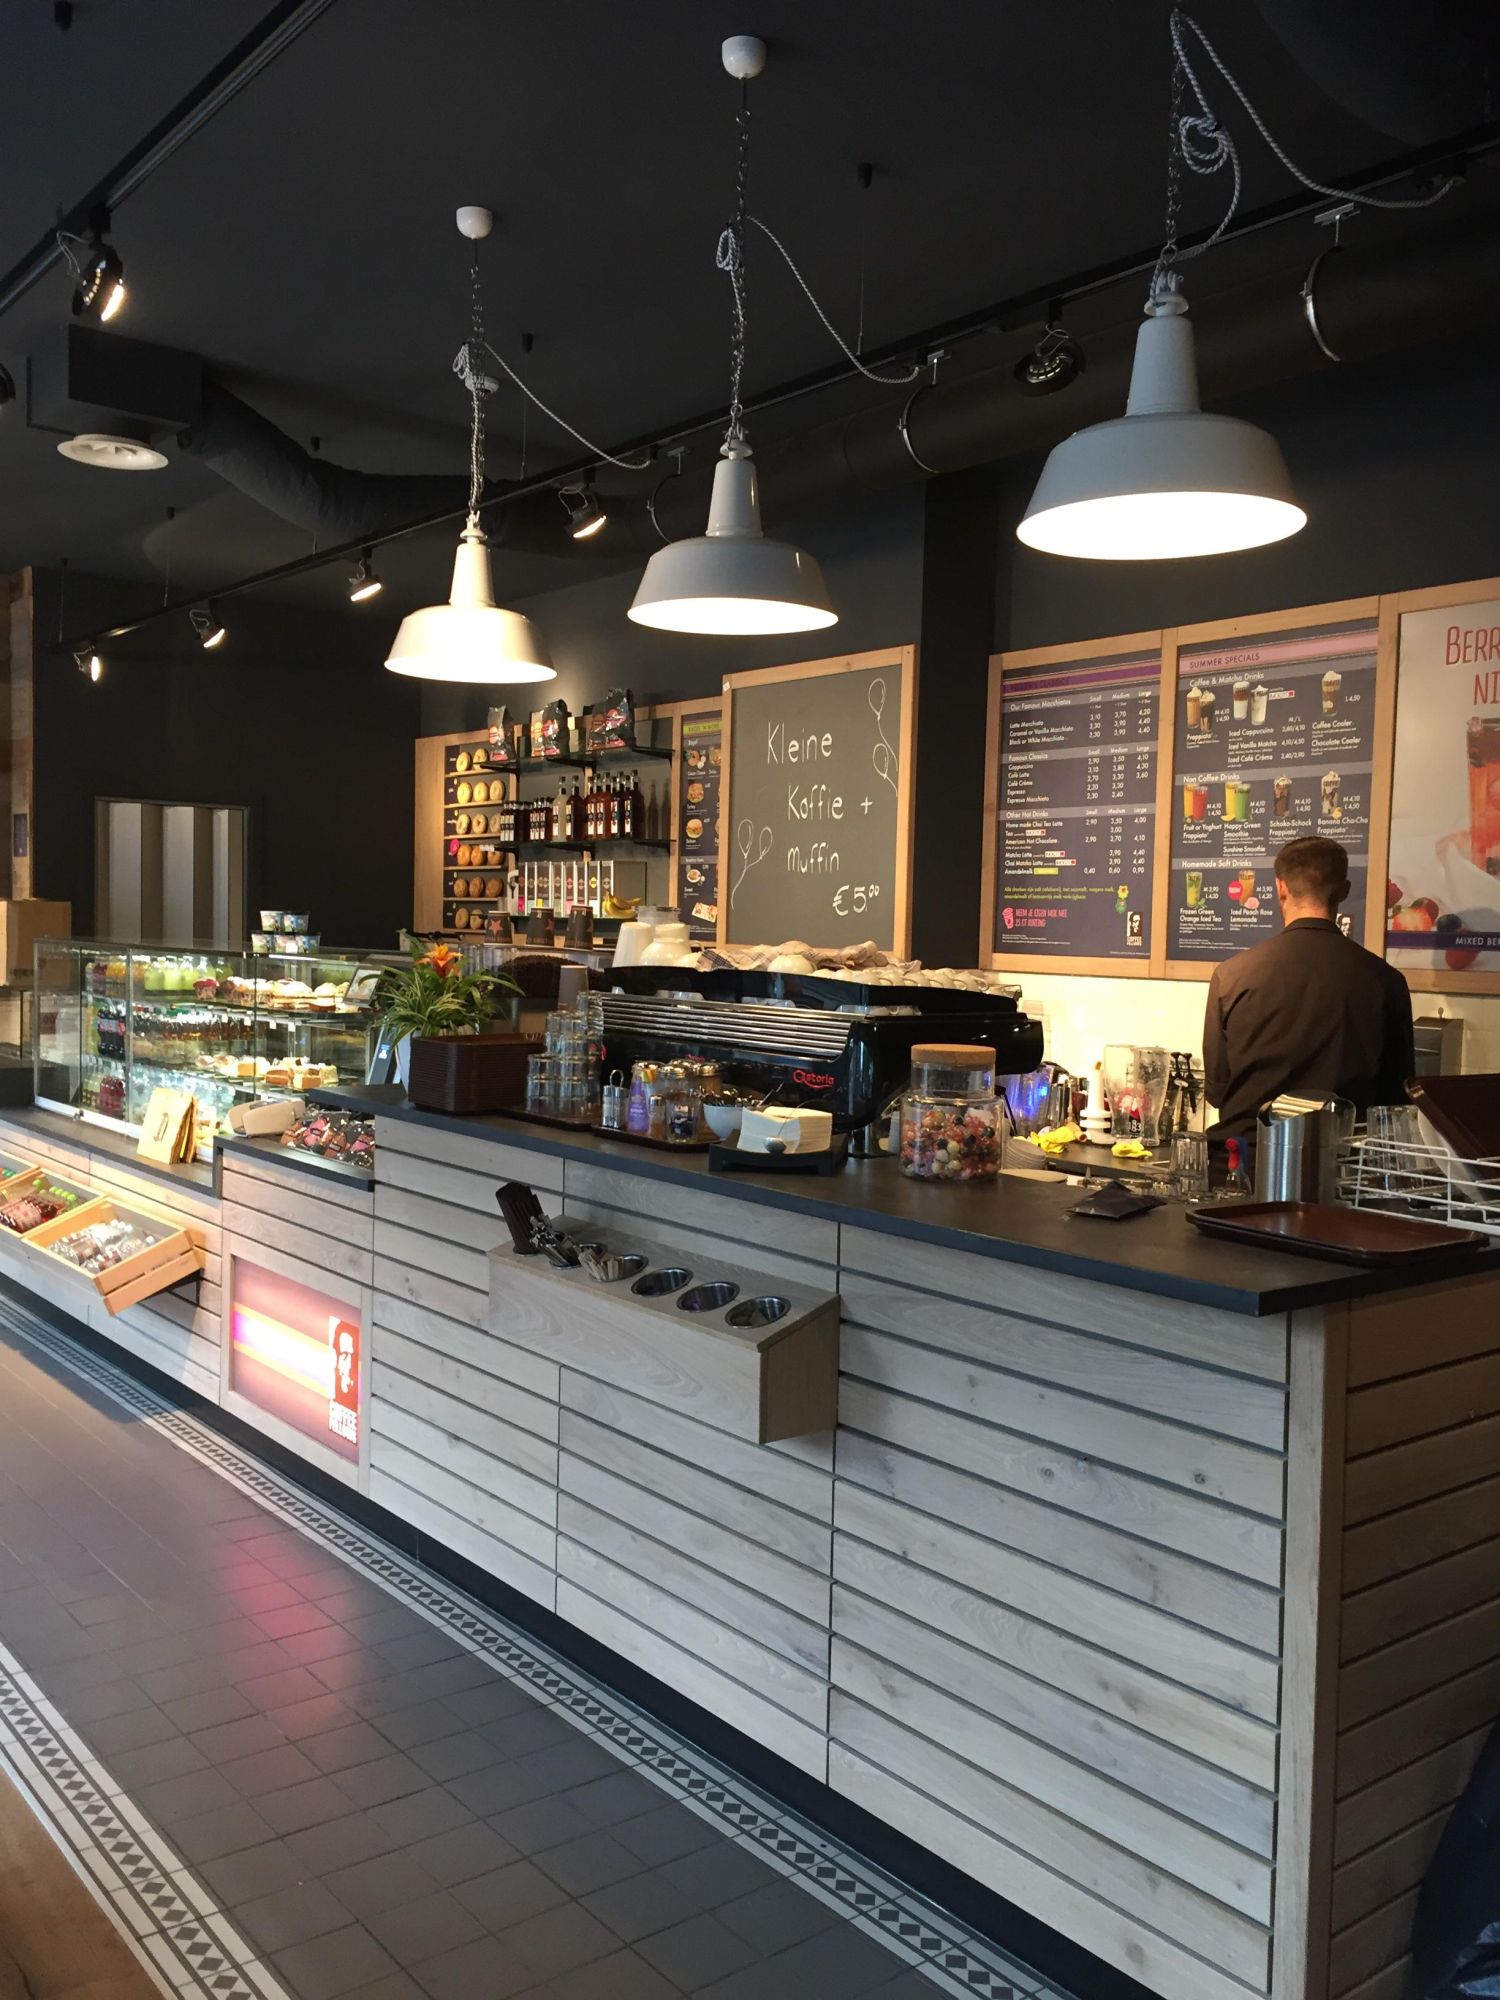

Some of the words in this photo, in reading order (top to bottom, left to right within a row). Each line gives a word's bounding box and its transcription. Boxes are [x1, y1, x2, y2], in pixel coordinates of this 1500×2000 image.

[1190, 657, 1222, 669] SUMMER
[1225, 653, 1260, 664] SPECIALS
[1190, 678, 1209, 687] Coffee
[1219, 675, 1242, 684] Matcha
[1242, 728, 1274, 736] Cappuccino
[768, 721, 832, 764] Kleine
[788, 784, 844, 820] Koffie
[860, 796, 872, 815] +
[1455, 936, 1484, 946] MIXED
[791, 1069, 835, 1089] Astoria
